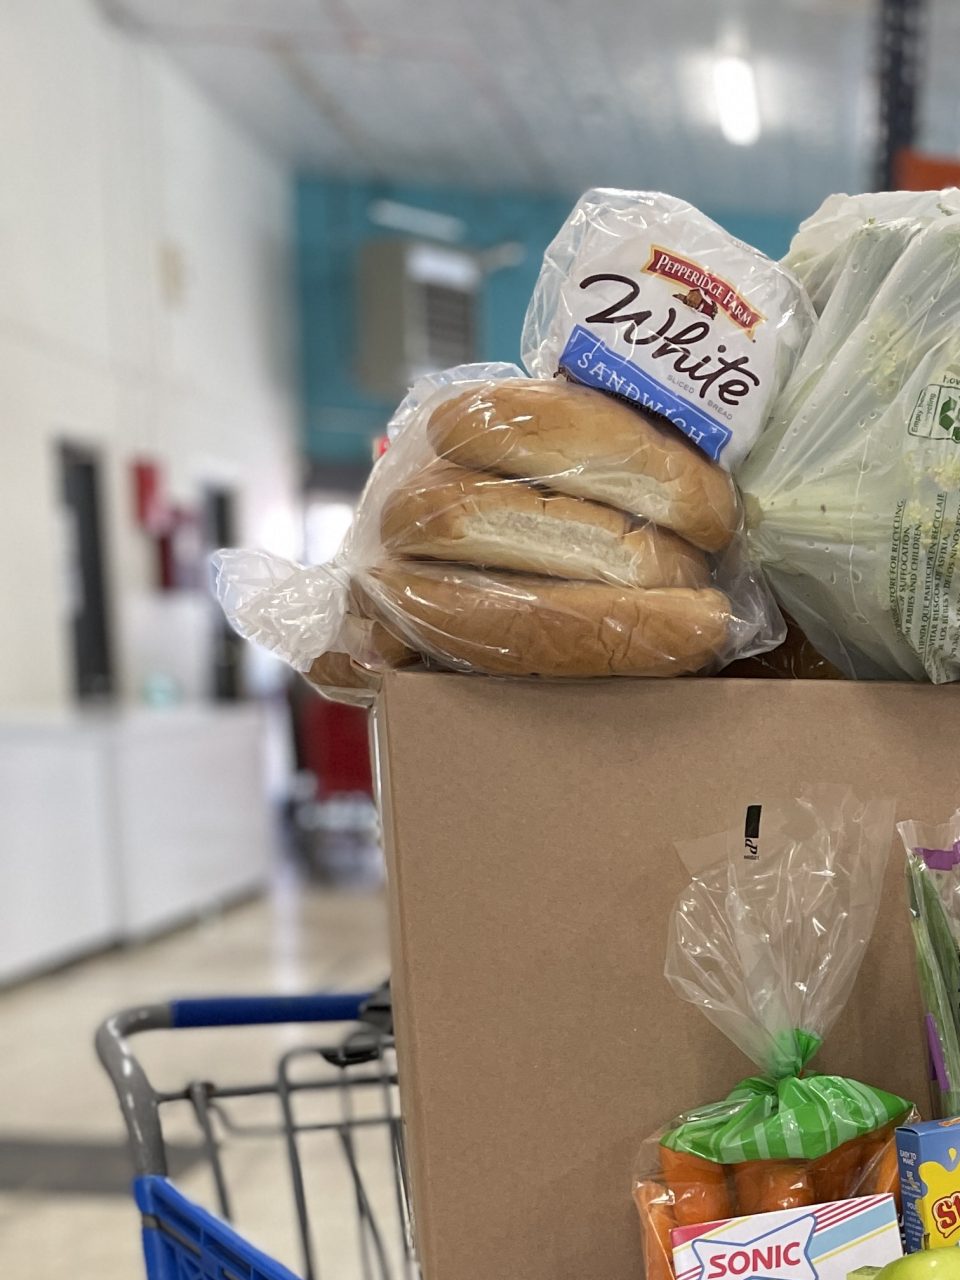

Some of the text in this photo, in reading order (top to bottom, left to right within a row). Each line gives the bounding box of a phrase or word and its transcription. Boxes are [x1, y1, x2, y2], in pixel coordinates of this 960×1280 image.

[656, 254, 752, 325] PEPPERIDGE FARM
[579, 273, 760, 406] White
[667, 374, 733, 421] SLICED BREAD
[889, 555, 898, 575] FOR
[909, 573, 918, 594] AND
[921, 604, 931, 622] QUE
[928, 623, 938, 648] VITAR
[707, 1242, 801, 1280] SONIC
